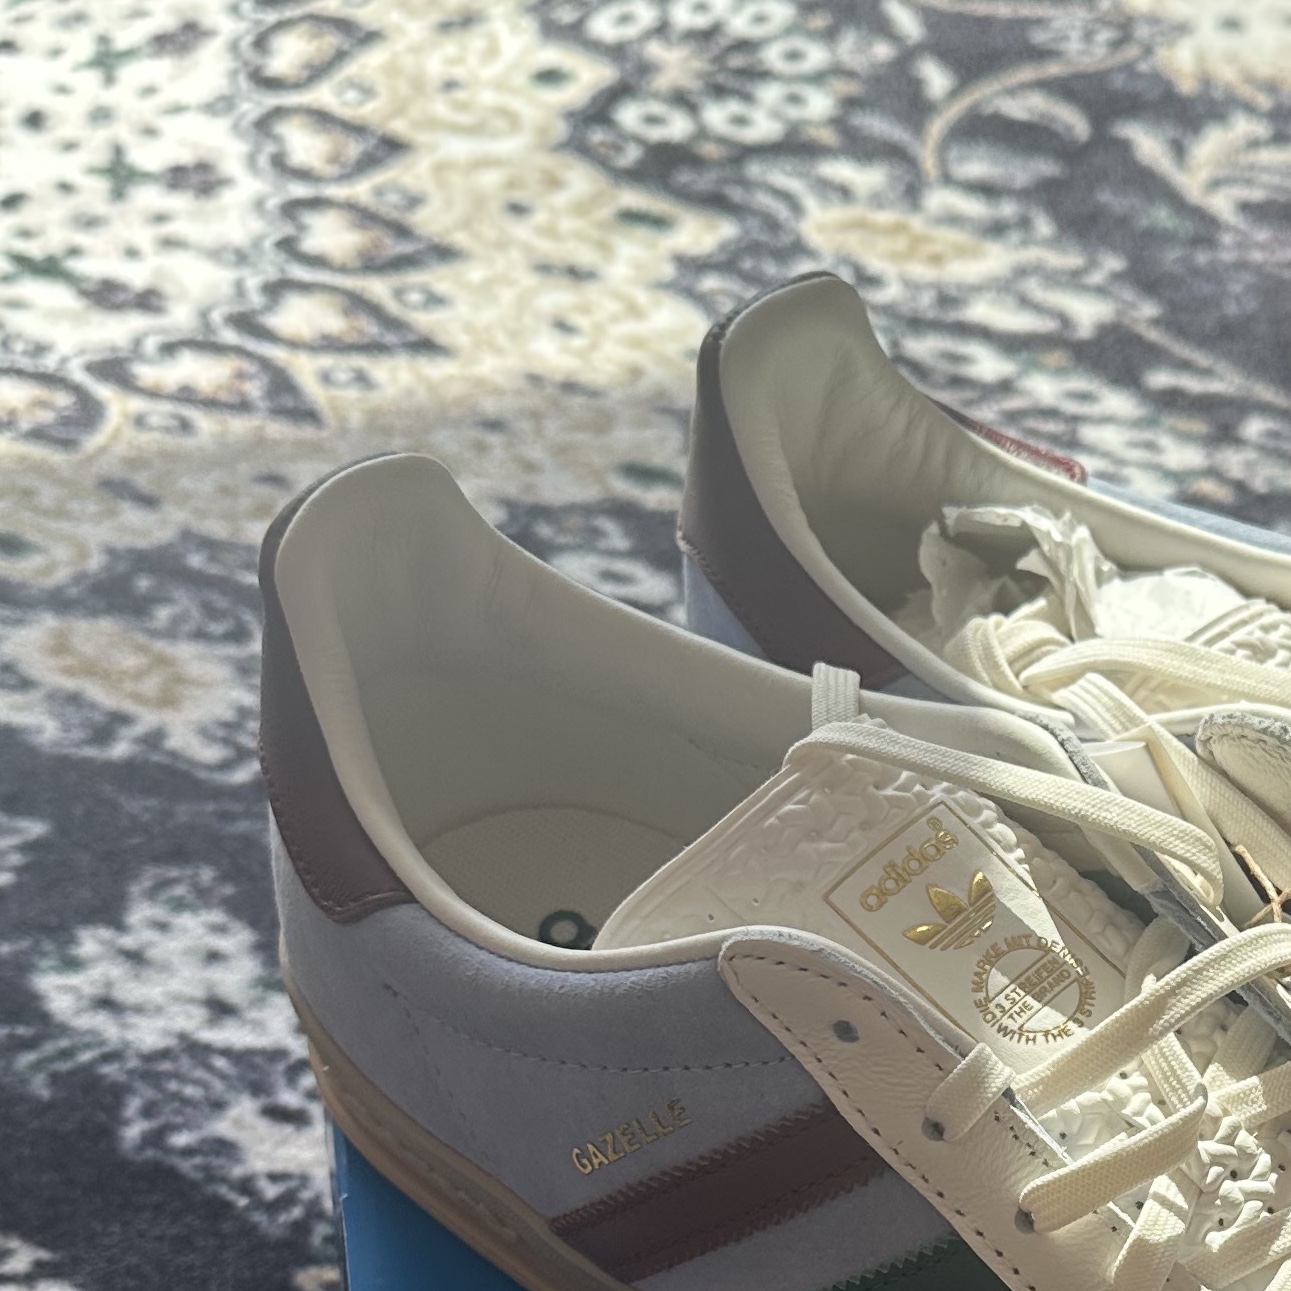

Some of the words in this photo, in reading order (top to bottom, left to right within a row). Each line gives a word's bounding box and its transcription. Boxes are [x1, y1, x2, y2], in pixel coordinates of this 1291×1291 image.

[971, 942, 1004, 993] MARKE
[1004, 933, 1033, 951] MIT
[994, 1003, 1006, 1014] 3
[1004, 955, 1061, 1005] STREIFEN
[1007, 1000, 1035, 1023] THE
[1031, 968, 1072, 1002] BRAND
[972, 996, 997, 1025] DIE
[996, 1022, 1037, 1045] WITH
[1042, 1024, 1075, 1044] THE
[571, 1098, 695, 1175] GAZELLE
